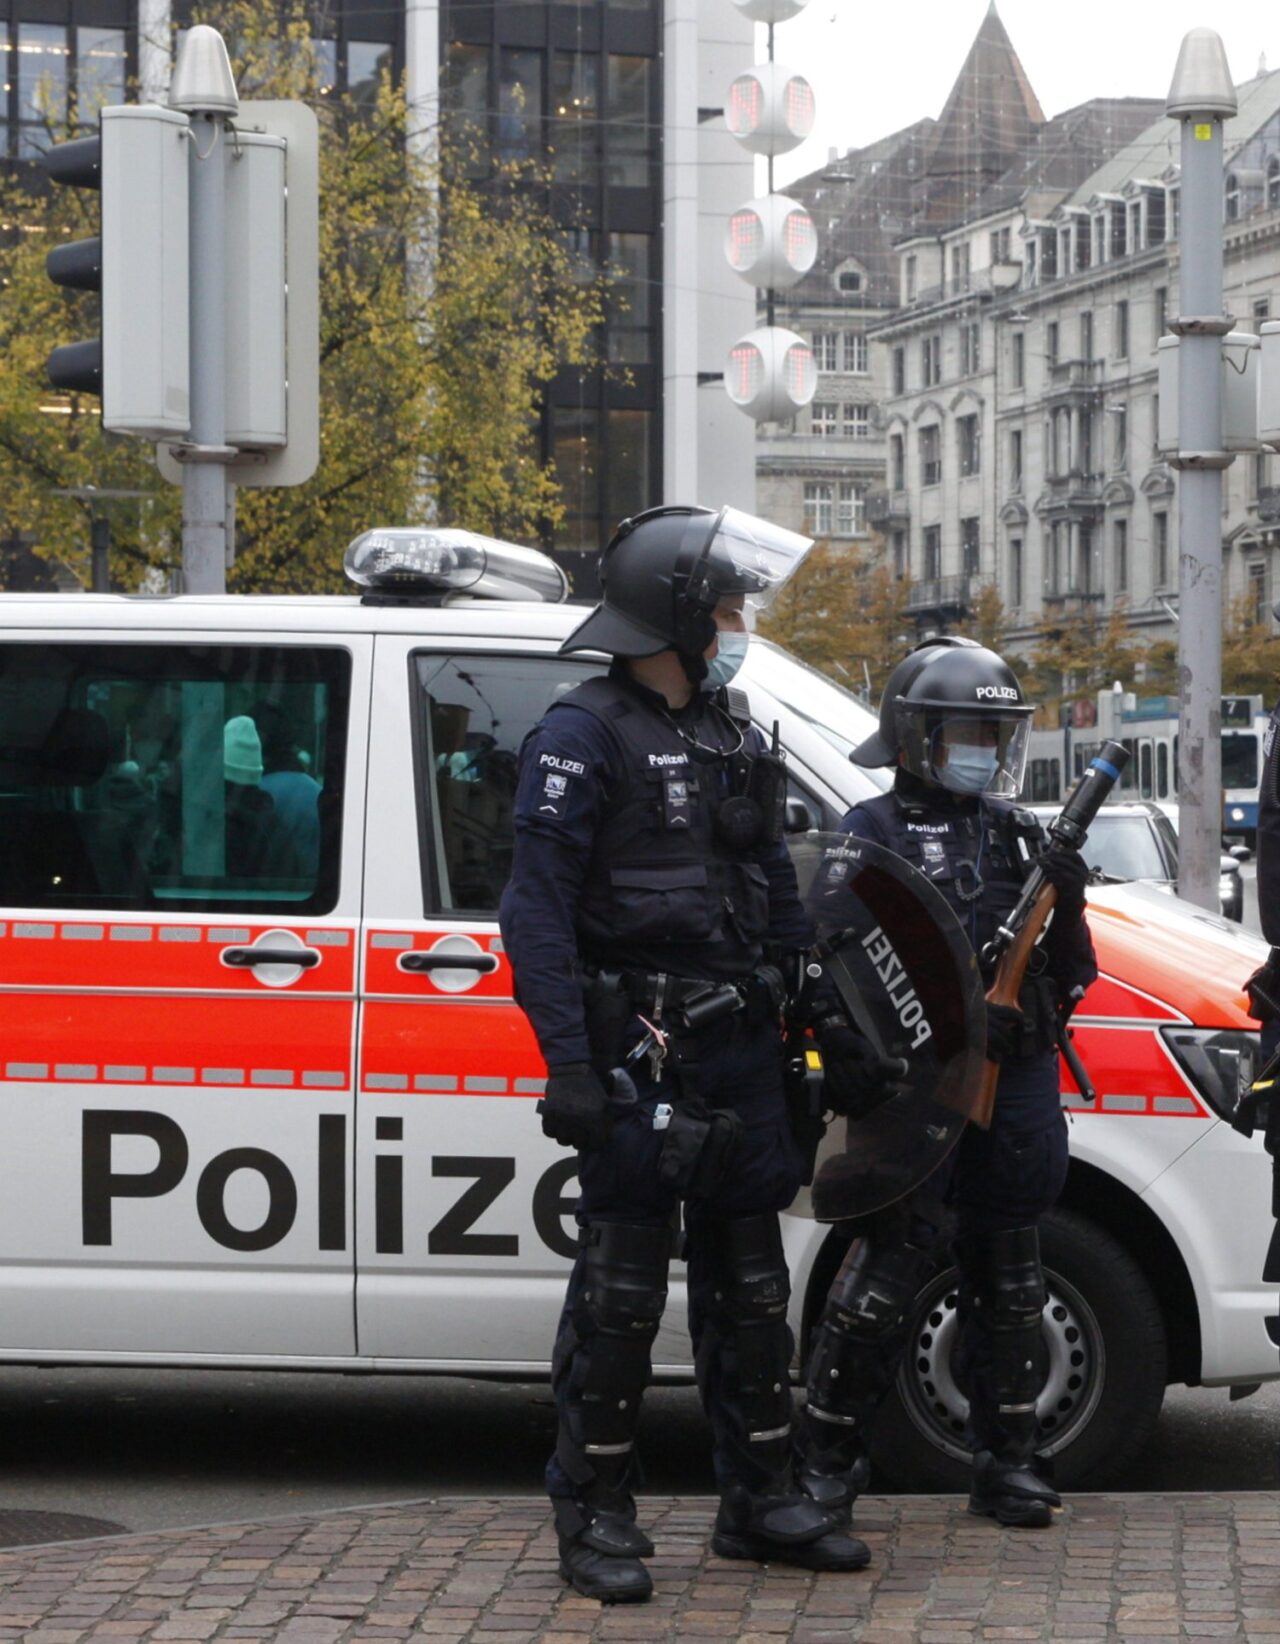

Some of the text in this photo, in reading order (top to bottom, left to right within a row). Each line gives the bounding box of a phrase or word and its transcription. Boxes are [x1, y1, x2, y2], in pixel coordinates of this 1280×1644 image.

[975, 686, 1018, 701] POLIZEI
[539, 754, 585, 775] POLIZEI
[648, 753, 689, 766] Polizei
[907, 822, 950, 833] Polizei
[82, 1109, 583, 1261] Polize
